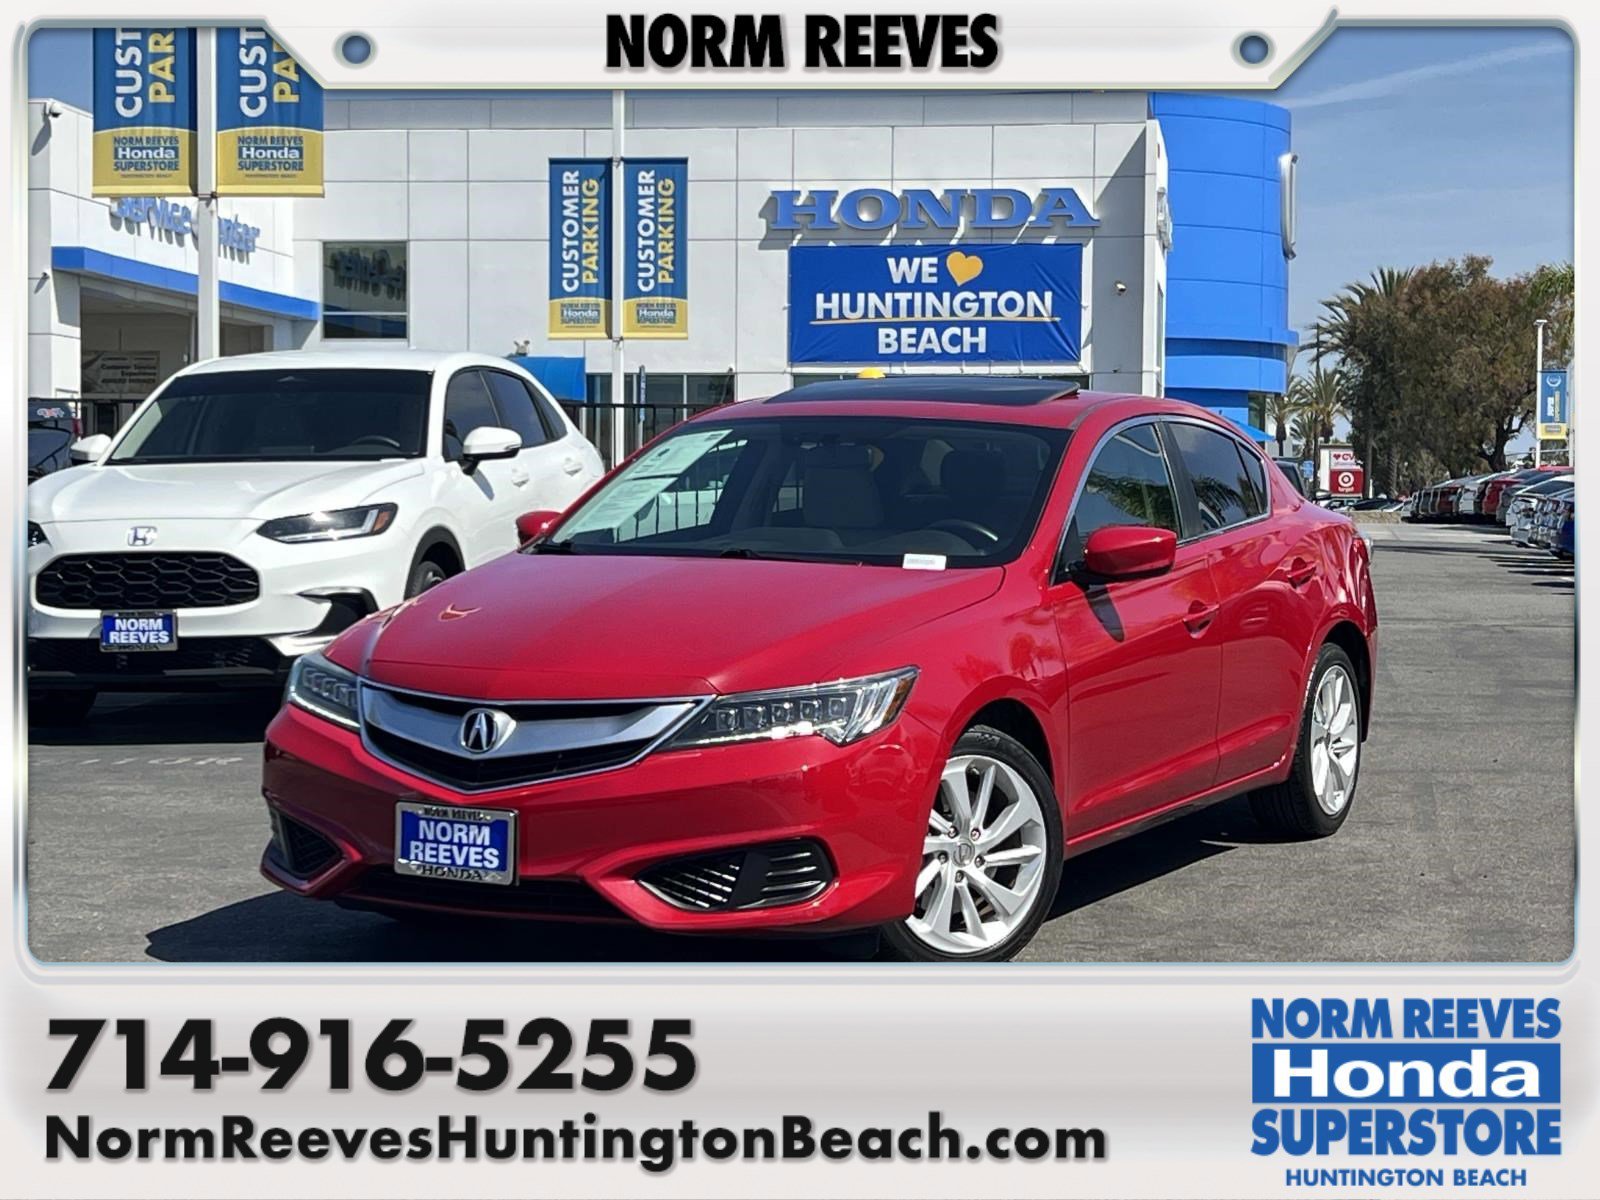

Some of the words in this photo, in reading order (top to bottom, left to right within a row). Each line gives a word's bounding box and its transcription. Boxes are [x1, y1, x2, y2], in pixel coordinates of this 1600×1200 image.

[113, 135, 143, 145] NORM
[145, 135, 179, 145] REEVES
[118, 147, 175, 159] Honda
[238, 135, 268, 145] NORM
[270, 135, 303, 145] REEVES
[242, 147, 299, 159] Honda
[113, 160, 179, 171] SUPERSTORE
[238, 160, 304, 171] SUPERSTORE
[771, 187, 1100, 231] HONDA
[562, 170, 580, 293] CUSTOMER
[582, 178, 599, 284] PARKING
[637, 170, 655, 292] CUSTOMER
[658, 178, 675, 284] PARKING
[887, 257, 938, 284] WE
[815, 291, 1053, 320] HUNTINGTON
[877, 327, 987, 355] BEACH
[109, 631, 169, 644] REEVES
[115, 618, 163, 631] NORM
[418, 819, 490, 846] NORM
[409, 840, 499, 869] REEVES
[421, 865, 483, 881] HONDA
